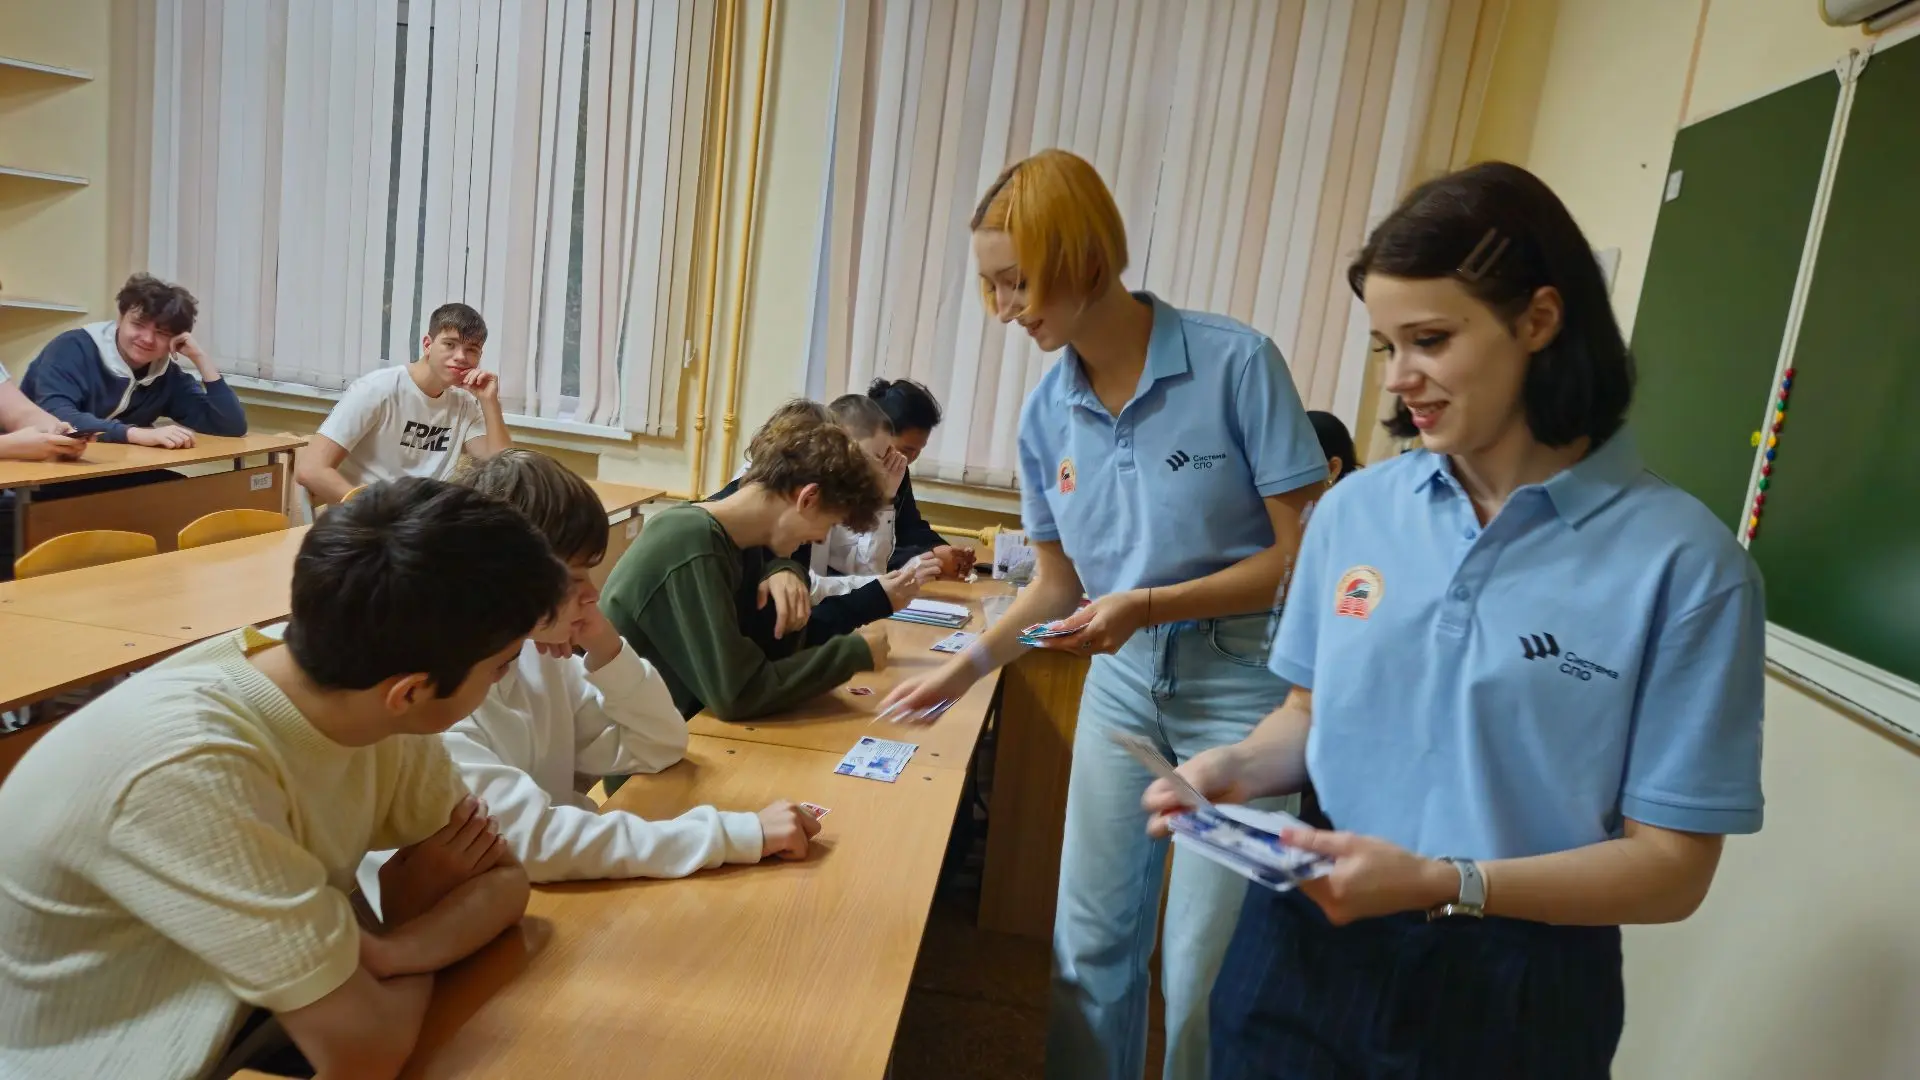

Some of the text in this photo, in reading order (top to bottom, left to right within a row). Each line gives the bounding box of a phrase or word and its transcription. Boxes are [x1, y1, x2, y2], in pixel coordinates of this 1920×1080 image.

[400, 421, 451, 451] ERKE
[1193, 453, 1226, 462] Система
[1193, 462, 1213, 470] СПО
[1560, 663, 1592, 681] СПО
